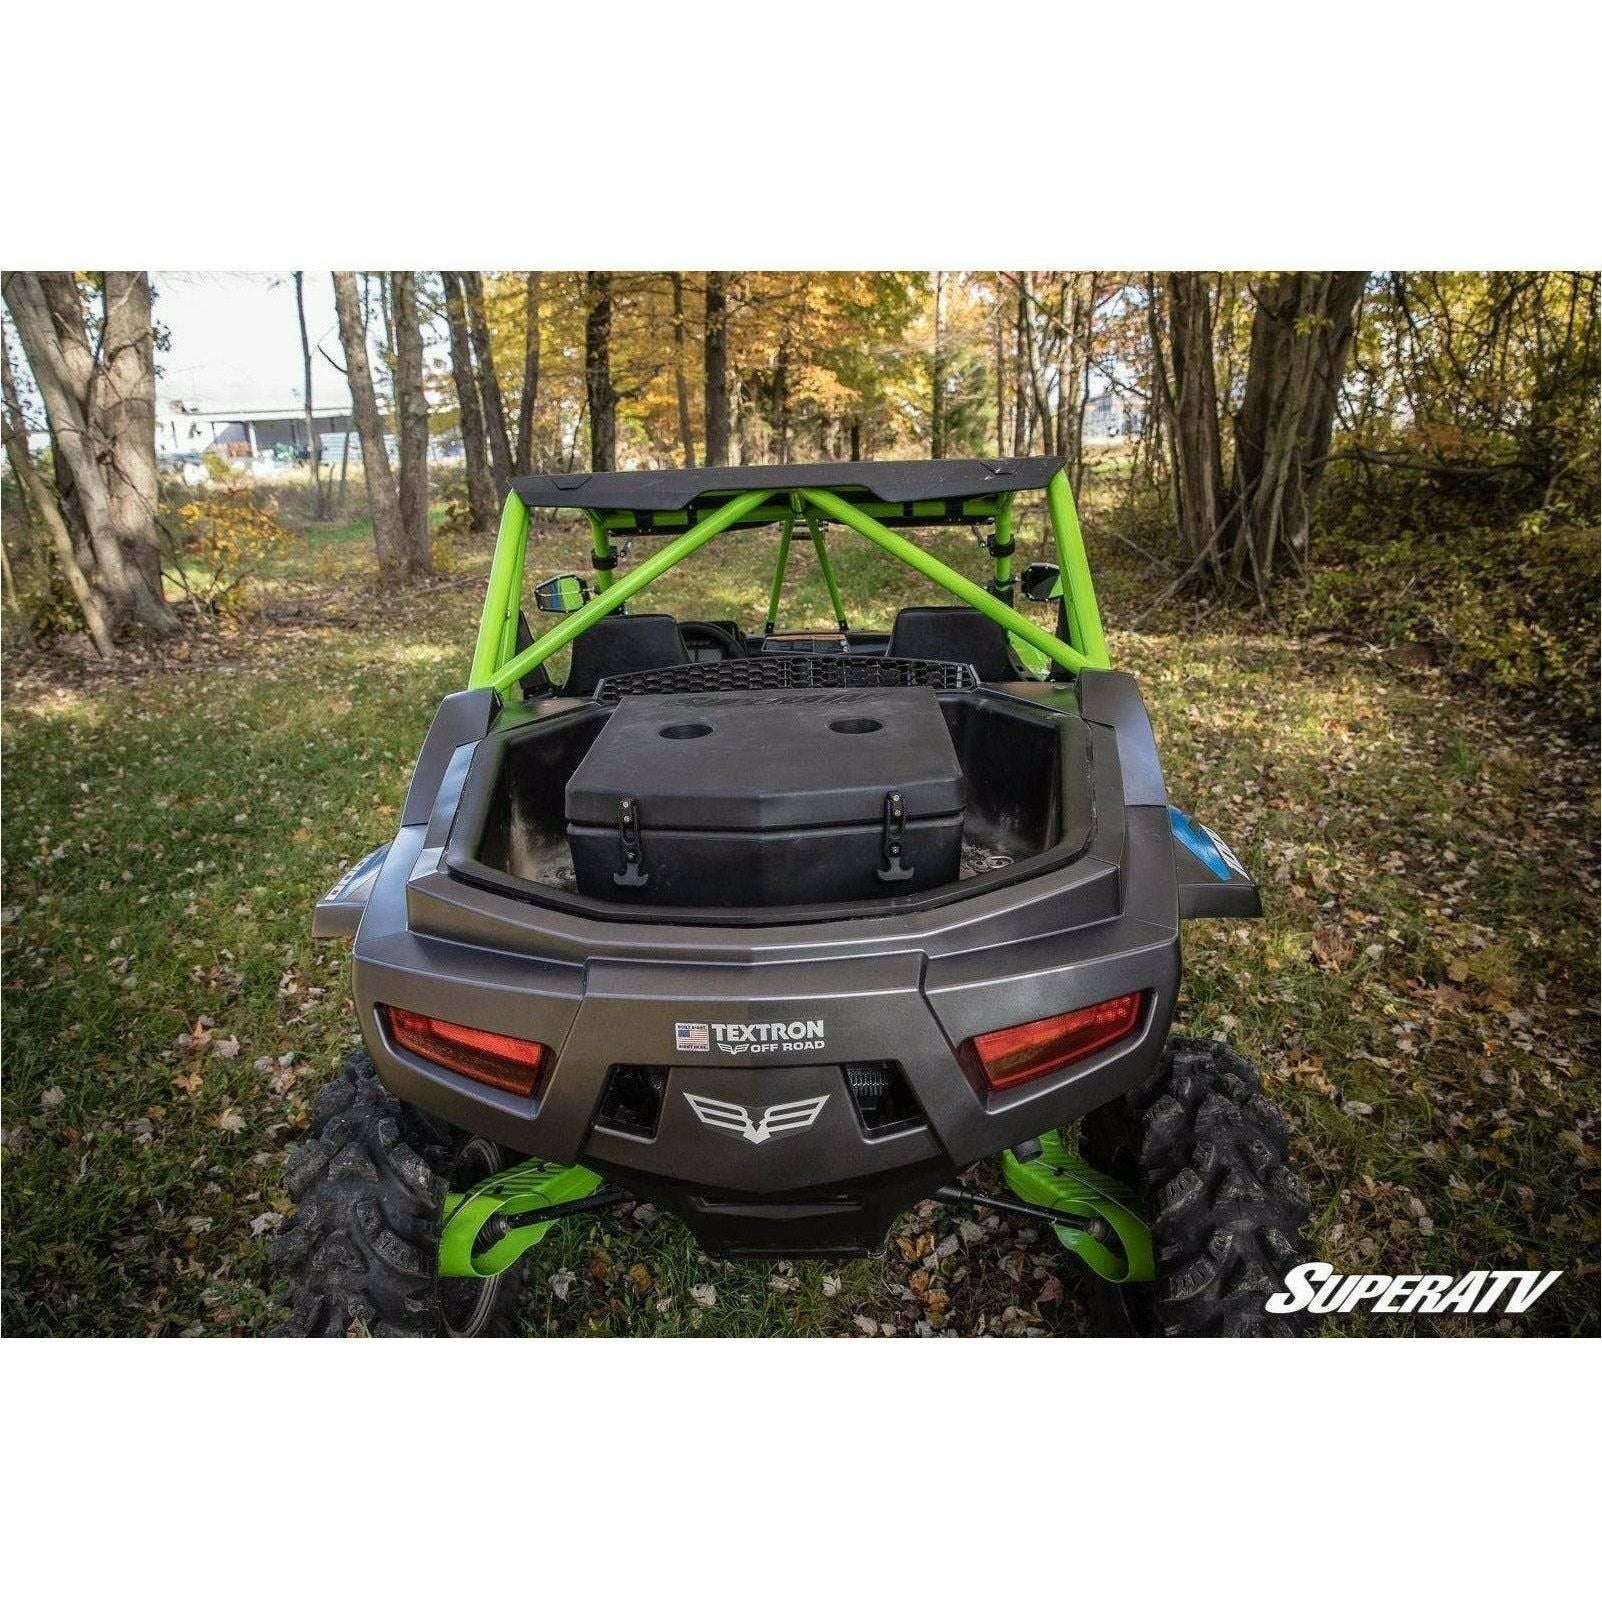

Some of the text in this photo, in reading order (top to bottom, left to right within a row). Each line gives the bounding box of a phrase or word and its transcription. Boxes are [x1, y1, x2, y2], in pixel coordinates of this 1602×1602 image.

[711, 1020, 824, 1042] TEXTRON
[750, 1040, 826, 1053] OFF ROAD
